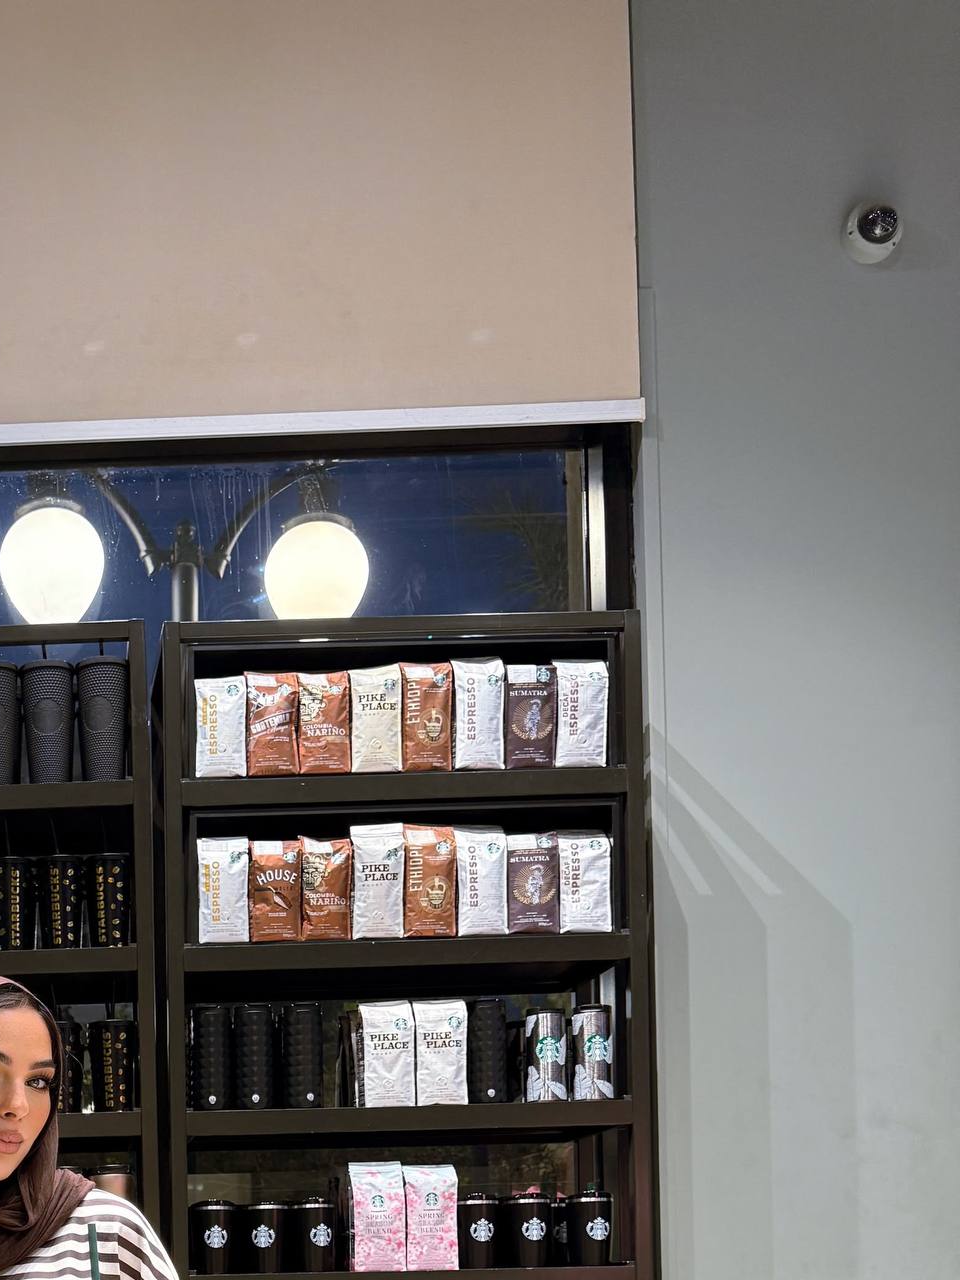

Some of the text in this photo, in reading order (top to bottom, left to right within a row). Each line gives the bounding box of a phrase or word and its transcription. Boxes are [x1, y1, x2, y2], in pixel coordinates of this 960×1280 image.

[358, 694, 386, 703] PIKE
[362, 703, 398, 711] PLACE
[467, 678, 476, 741] ESPRESSO
[209, 695, 217, 755] ESPRESSO
[303, 723, 333, 731] COLOMBIA
[307, 726, 346, 737] NARIÑO
[509, 855, 550, 863] SUMATRA
[361, 864, 390, 873] PIKE
[409, 846, 423, 892] ETHIOPI
[571, 843, 580, 904] ESPRESSO
[257, 869, 298, 886] HOUSE
[365, 873, 399, 881] PLACE
[468, 846, 479, 908] ESPRESSO
[212, 861, 220, 922] ESPRESSO
[11, 868, 20, 946] STARBUCKS
[50, 867, 61, 944] STARBUCKS
[96, 866, 106, 942] STARBUCKS
[370, 1033, 399, 1042] PIKE
[423, 1031, 452, 1041] PIKE
[373, 1042, 409, 1050] PLACE
[426, 1040, 462, 1049] PLACE
[103, 1031, 114, 1107] STARBUCKS
